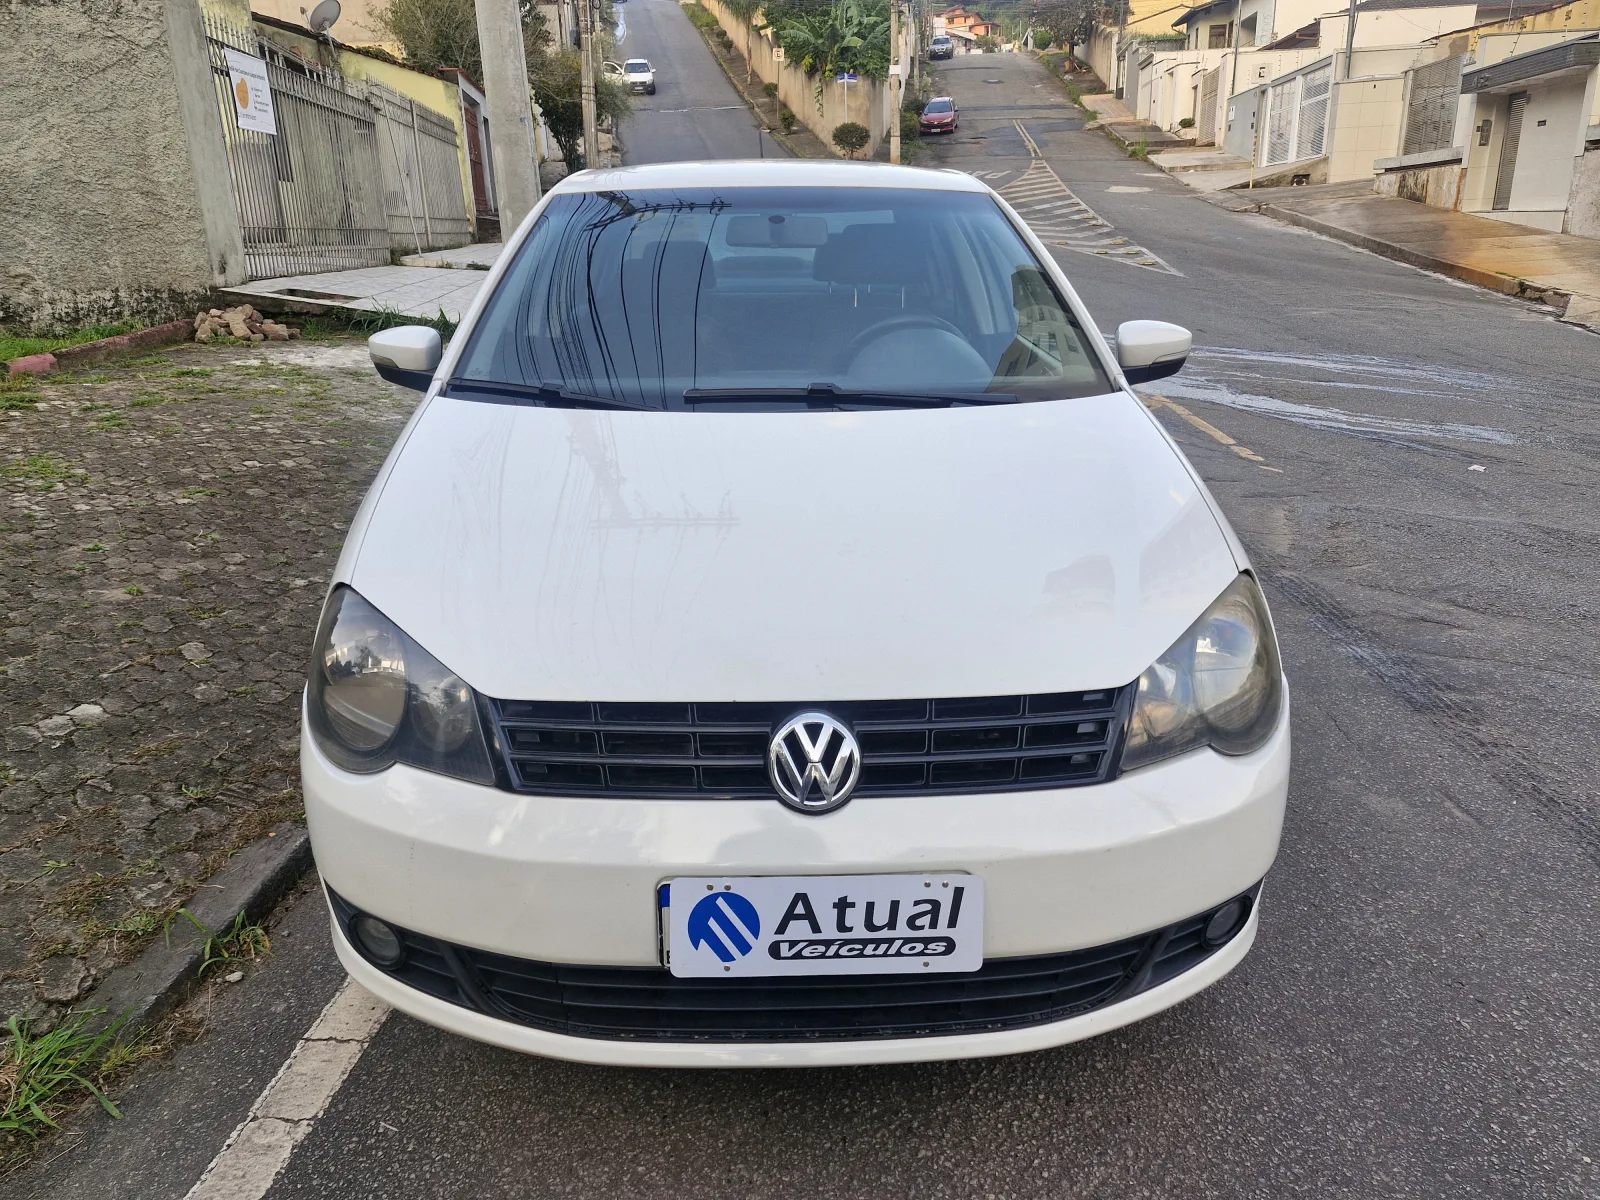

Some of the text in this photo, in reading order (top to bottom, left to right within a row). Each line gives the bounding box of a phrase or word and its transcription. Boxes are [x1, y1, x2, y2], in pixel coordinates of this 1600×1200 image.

[771, 716, 859, 808] VW
[774, 886, 965, 935] Atual
[779, 939, 948, 958] Veículos
